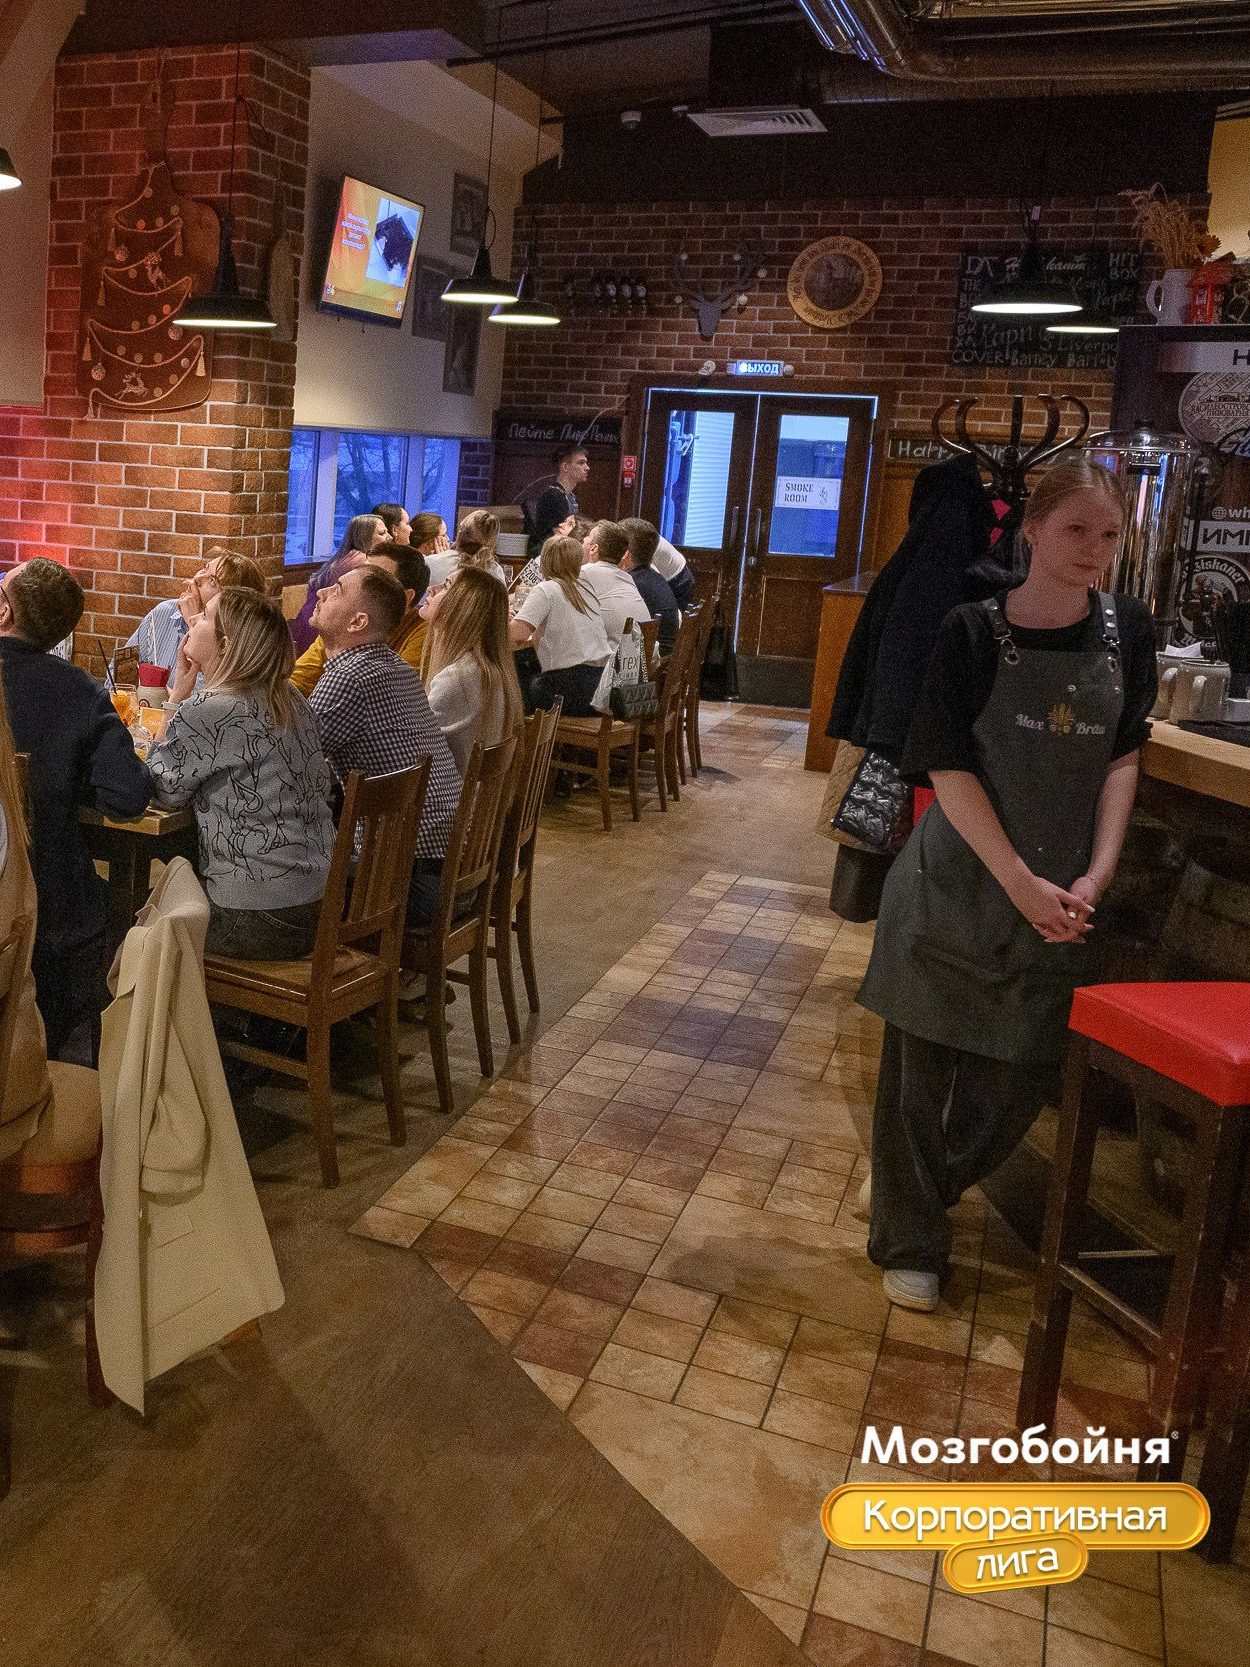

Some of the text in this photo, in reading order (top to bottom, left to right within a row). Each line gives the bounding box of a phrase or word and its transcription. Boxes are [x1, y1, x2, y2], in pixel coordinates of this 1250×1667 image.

[784, 482, 814, 494] SMOKE
[784, 493, 808, 504] ROOM
[1014, 713, 1045, 731] Max
